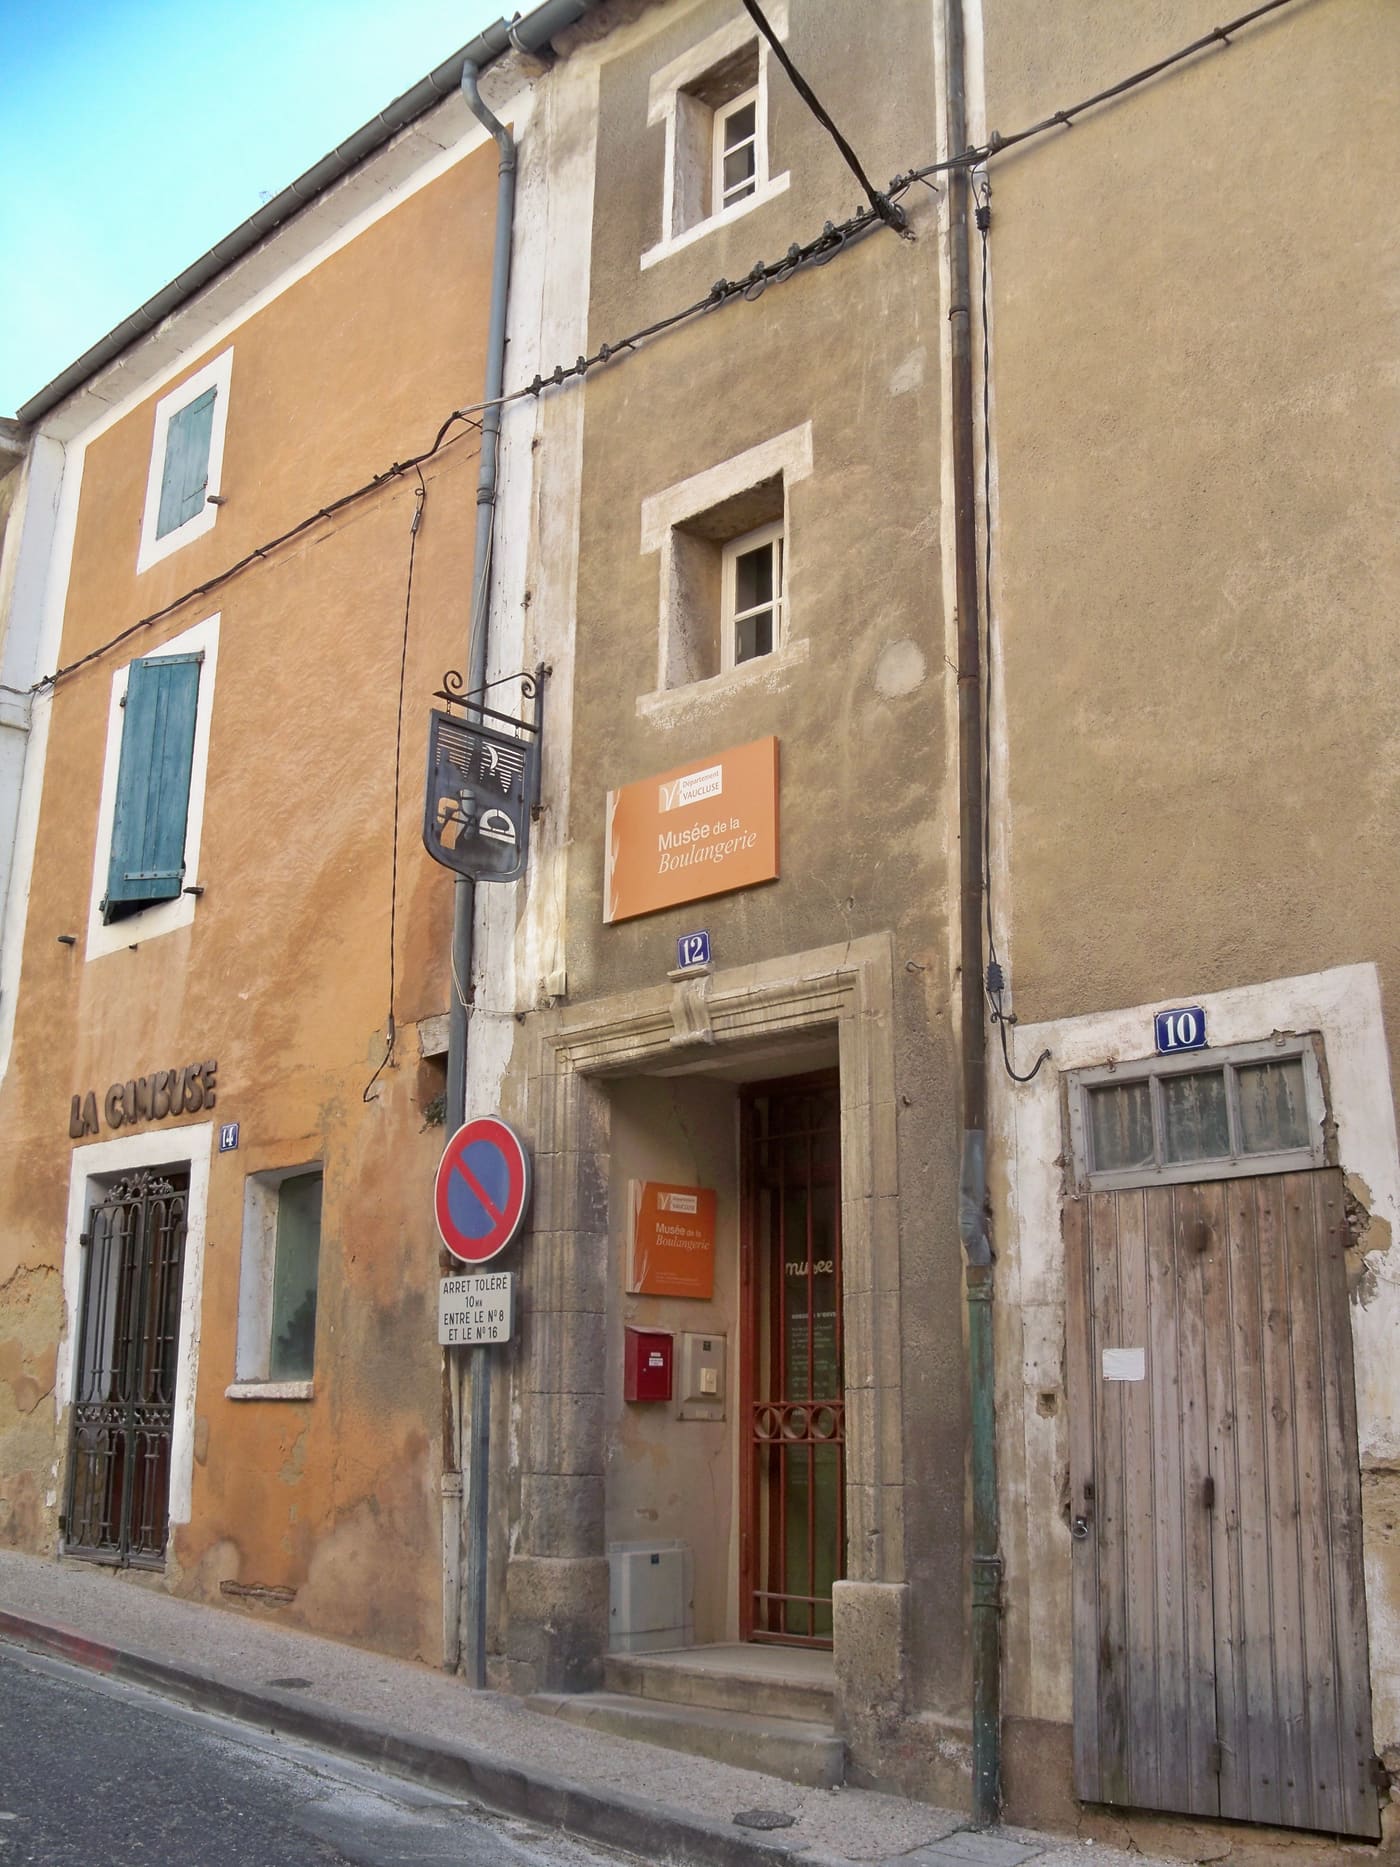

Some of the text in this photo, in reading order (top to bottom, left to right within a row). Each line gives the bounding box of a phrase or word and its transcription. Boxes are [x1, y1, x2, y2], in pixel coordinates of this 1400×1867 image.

[682, 782, 720, 801] VAUCLUSE
[658, 817, 740, 852] Musée de la
[657, 830, 757, 874] Boulangerie
[684, 936, 704, 965] 12
[1165, 1012, 1197, 1048] 10
[69, 1059, 218, 1139] LA CAMBUSE
[222, 1126, 234, 1149] 14
[655, 1222, 686, 1236] Musée
[655, 1234, 710, 1250] Boulangerie
[443, 1275, 508, 1294] ARRET TOLÉRÉ
[444, 1312, 470, 1325] ENTRE
[474, 1310, 484, 1323] LE
[449, 1328, 458, 1341] ET
[462, 1327, 472, 1340] LE
